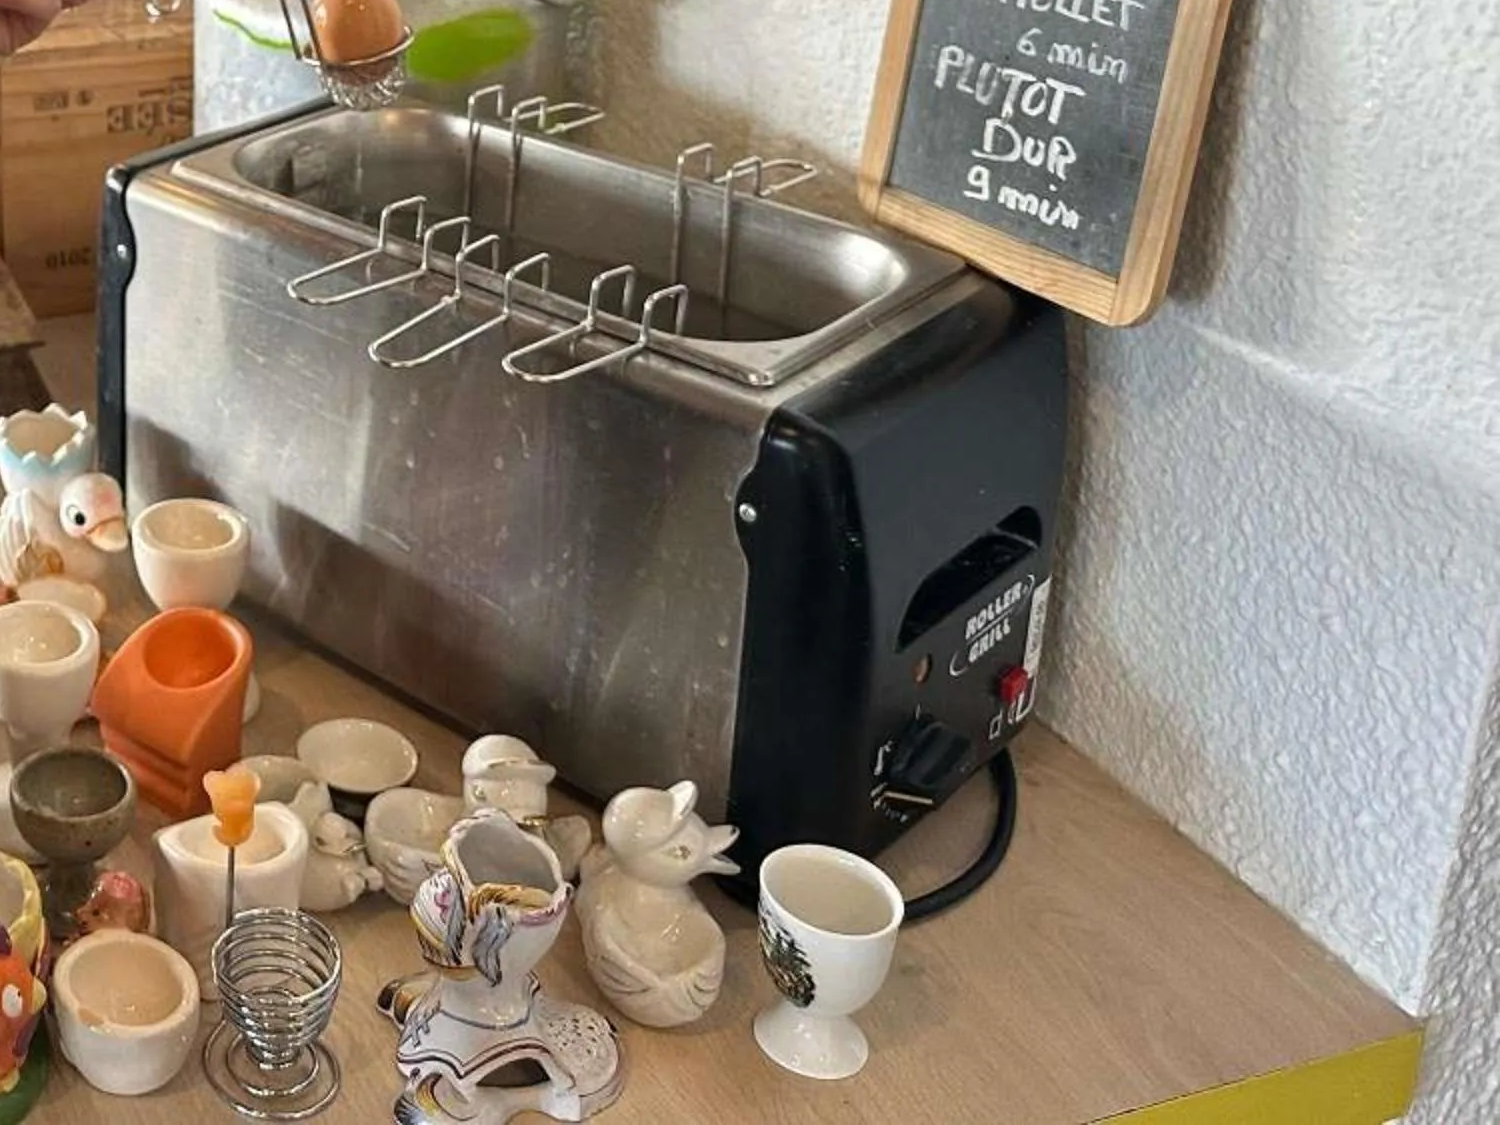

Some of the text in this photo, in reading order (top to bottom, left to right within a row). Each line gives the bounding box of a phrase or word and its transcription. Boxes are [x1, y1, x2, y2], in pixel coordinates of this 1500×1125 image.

[934, 44, 1086, 125] PLUTOT
[1015, 27, 1129, 84] 6 min
[971, 117, 1077, 182] DUR
[963, 166, 1081, 231] 9 min
[964, 581, 1023, 641] ROLLER
[968, 617, 1011, 663] GRILL
